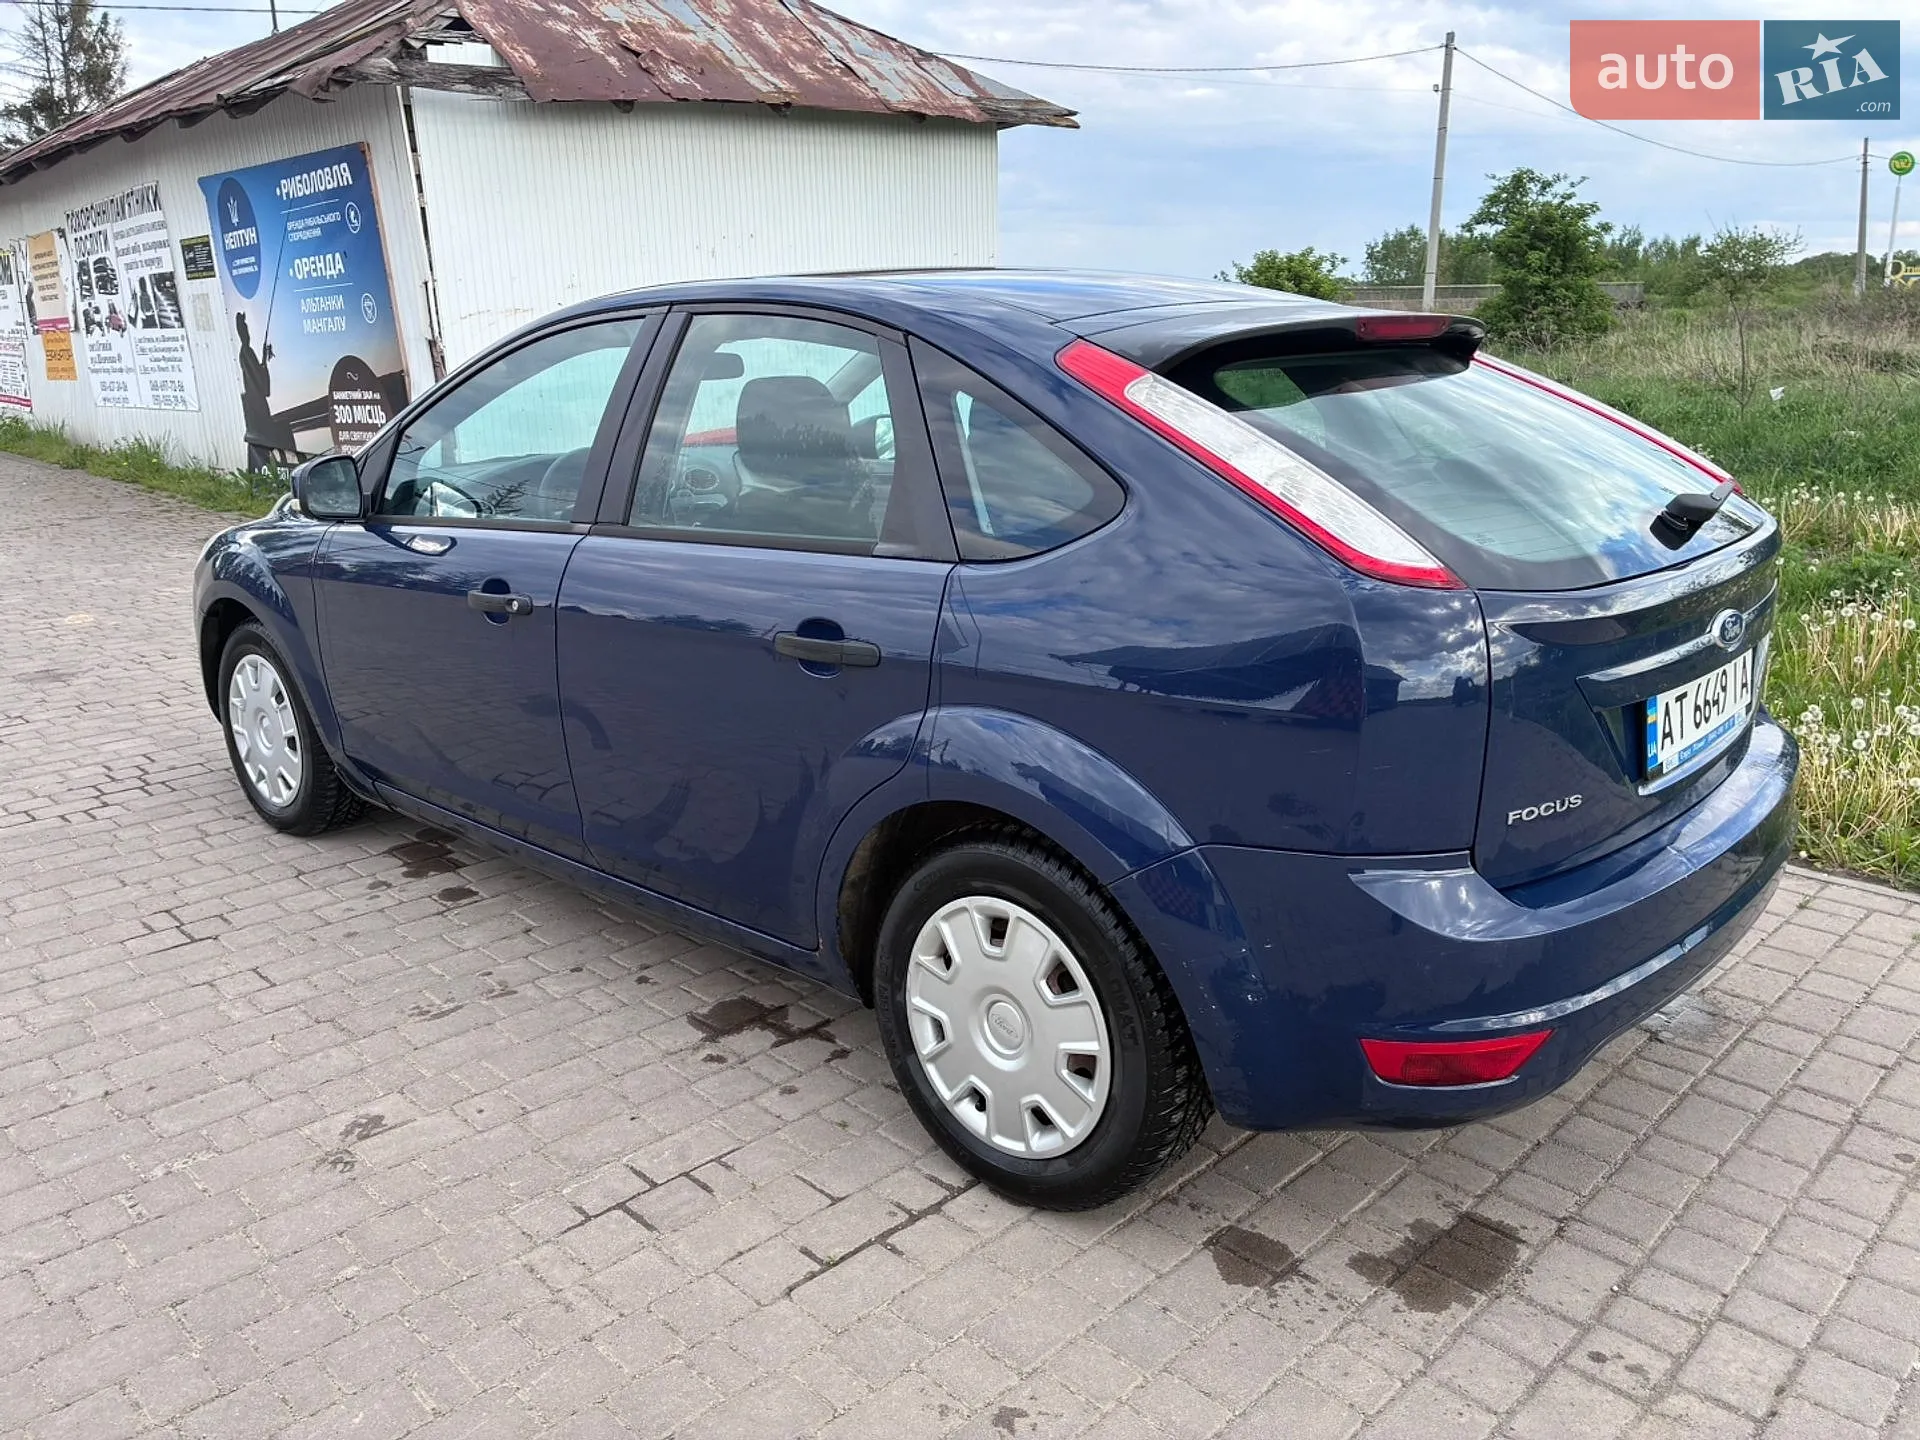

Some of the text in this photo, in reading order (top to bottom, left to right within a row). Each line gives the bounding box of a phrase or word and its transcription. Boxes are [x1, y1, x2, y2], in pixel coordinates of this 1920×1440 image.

[280, 162, 353, 200] РИБОЛОВЛЯ
[223, 227, 258, 250] НЕПТУН
[294, 252, 345, 280] ОРЕНДА
[301, 294, 345, 313] АЛЬТАНКИ
[303, 316, 346, 334] МАНГАЛУ
[333, 405, 386, 428] 300 МІСЦЬ
[1661, 691, 1688, 752] AT
[1693, 668, 1728, 730] 6649
[1734, 656, 1750, 705] IA
[1507, 794, 1583, 825] FOCUS
